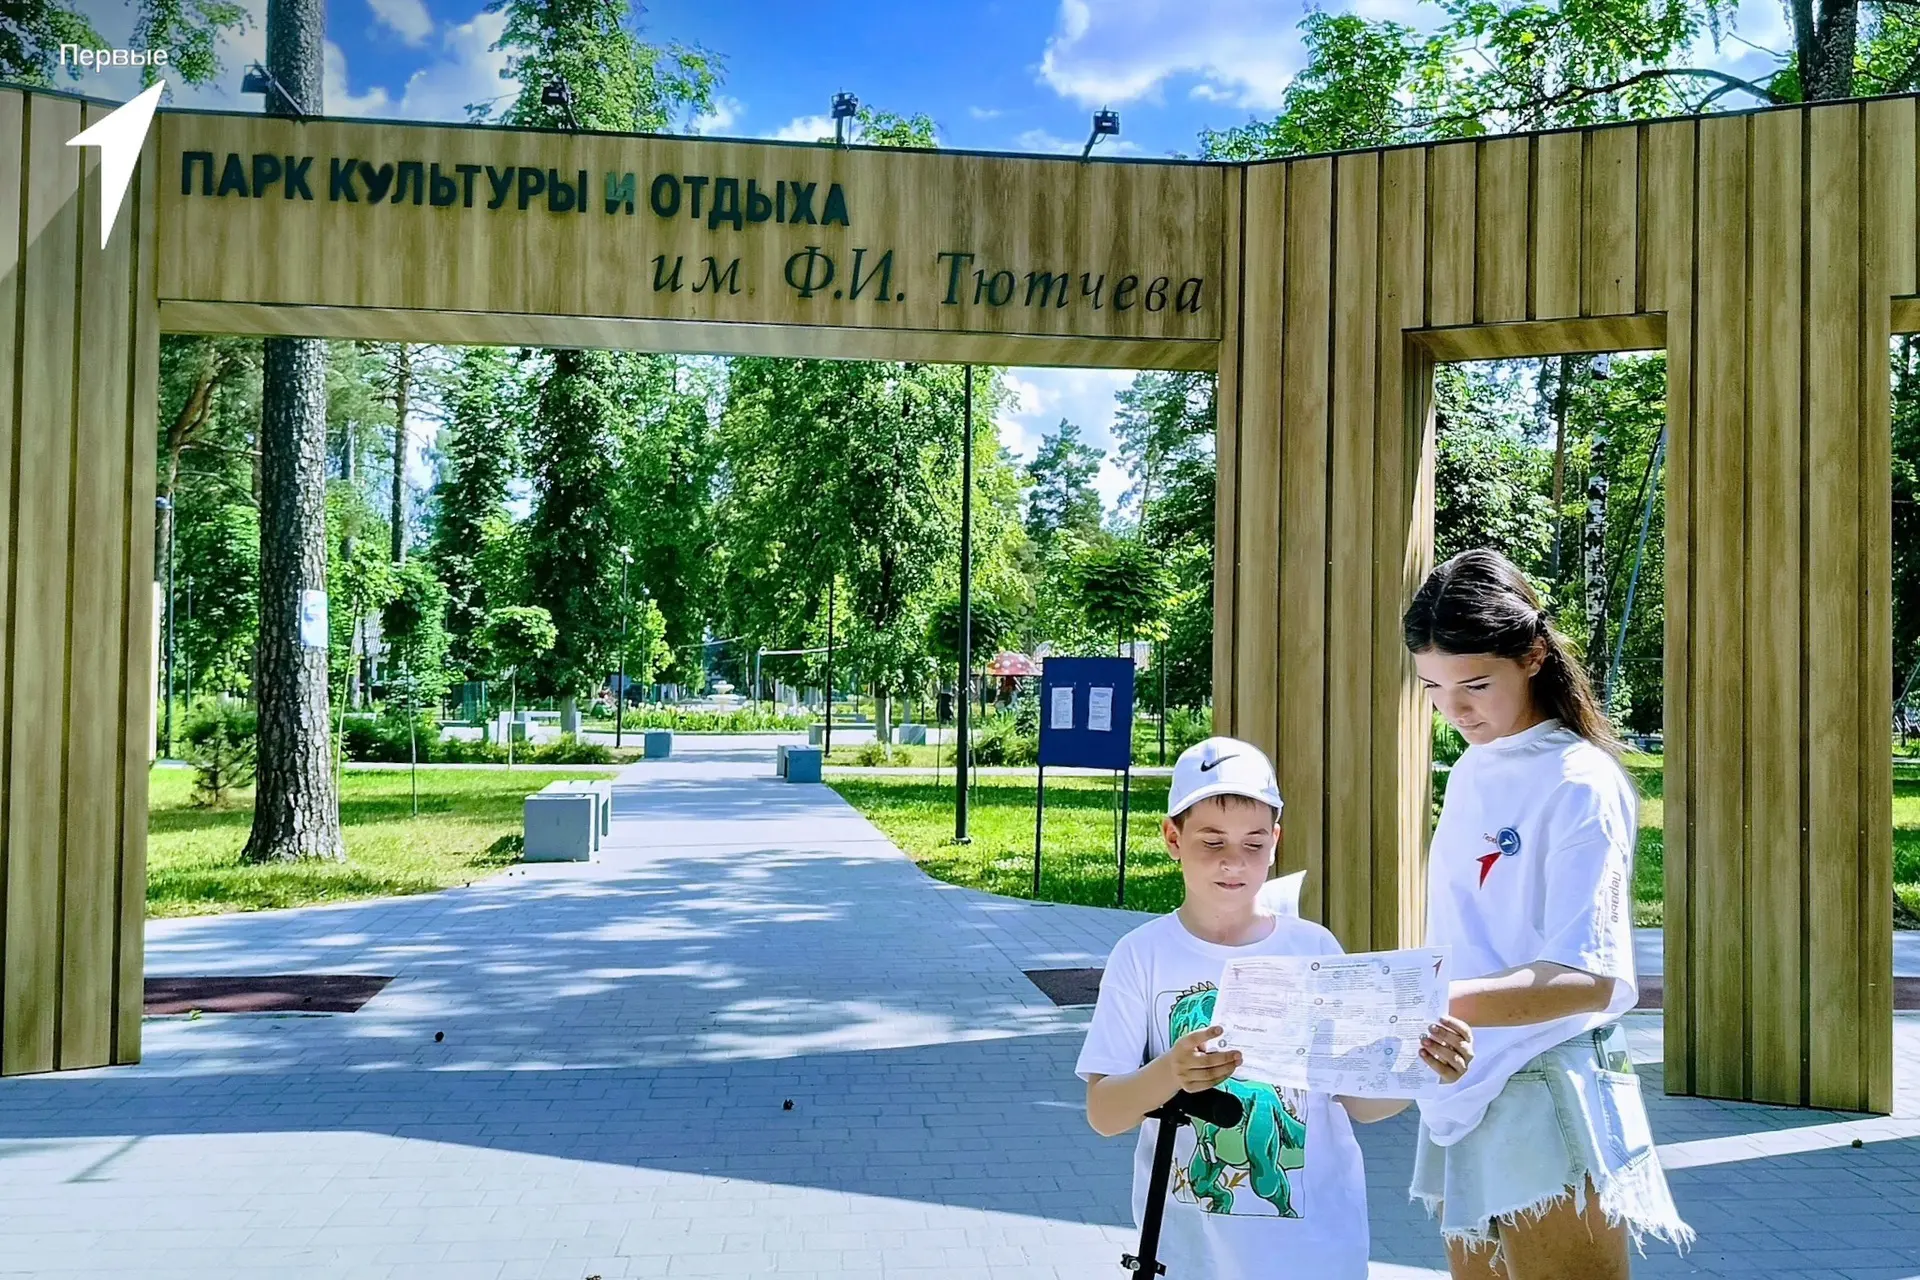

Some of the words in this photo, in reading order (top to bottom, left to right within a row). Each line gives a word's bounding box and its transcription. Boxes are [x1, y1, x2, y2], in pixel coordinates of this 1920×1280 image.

[181, 151, 314, 201] ПАРК
[329, 157, 587, 213] КУЛЬТУРЫ
[604, 171, 636, 215] И
[650, 173, 850, 231] ОТДЫХА
[784, 246, 904, 302] Ф.И.
[937, 252, 1203, 314] Тютчева
[1607, 870, 1622, 923] Первые
